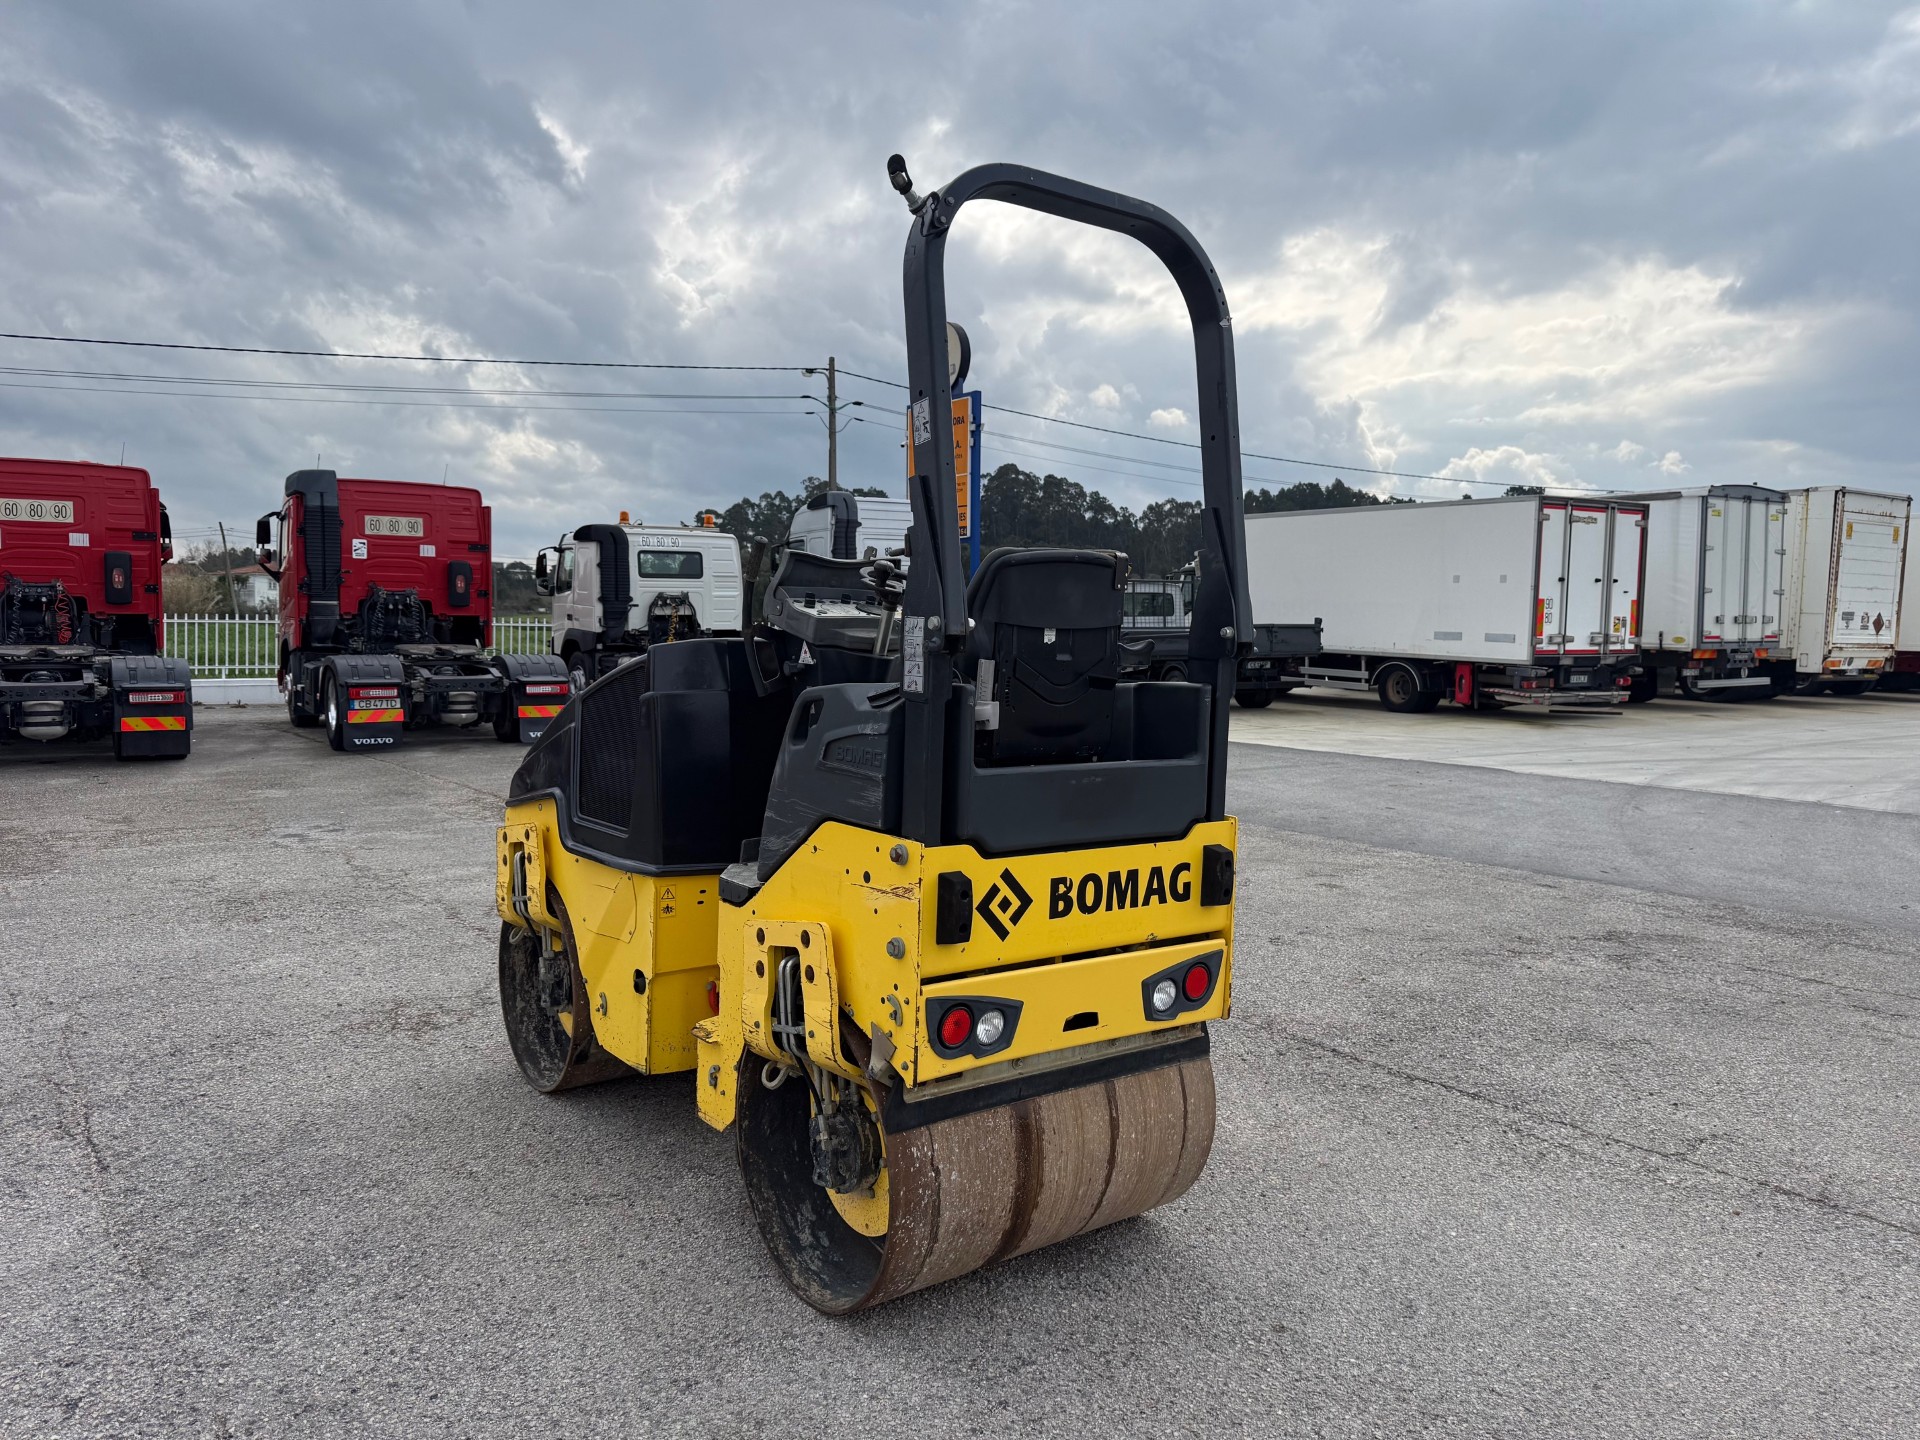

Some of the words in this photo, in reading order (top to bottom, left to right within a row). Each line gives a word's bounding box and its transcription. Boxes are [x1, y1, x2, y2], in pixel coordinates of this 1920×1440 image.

[4, 502, 18, 517] 60
[29, 503, 43, 518] 80
[53, 504, 67, 519] 90
[370, 519, 381, 532] 60
[389, 520, 400, 533] 80
[408, 521, 419, 534] 90
[641, 536, 651, 547] 60
[656, 537, 665, 548] 80
[670, 537, 680, 548] 90
[1545, 598, 1554, 610] 90
[353, 737, 394, 745] VOLVO
[835, 745, 883, 768] BOMAG
[1048, 861, 1192, 921] BOMAG
